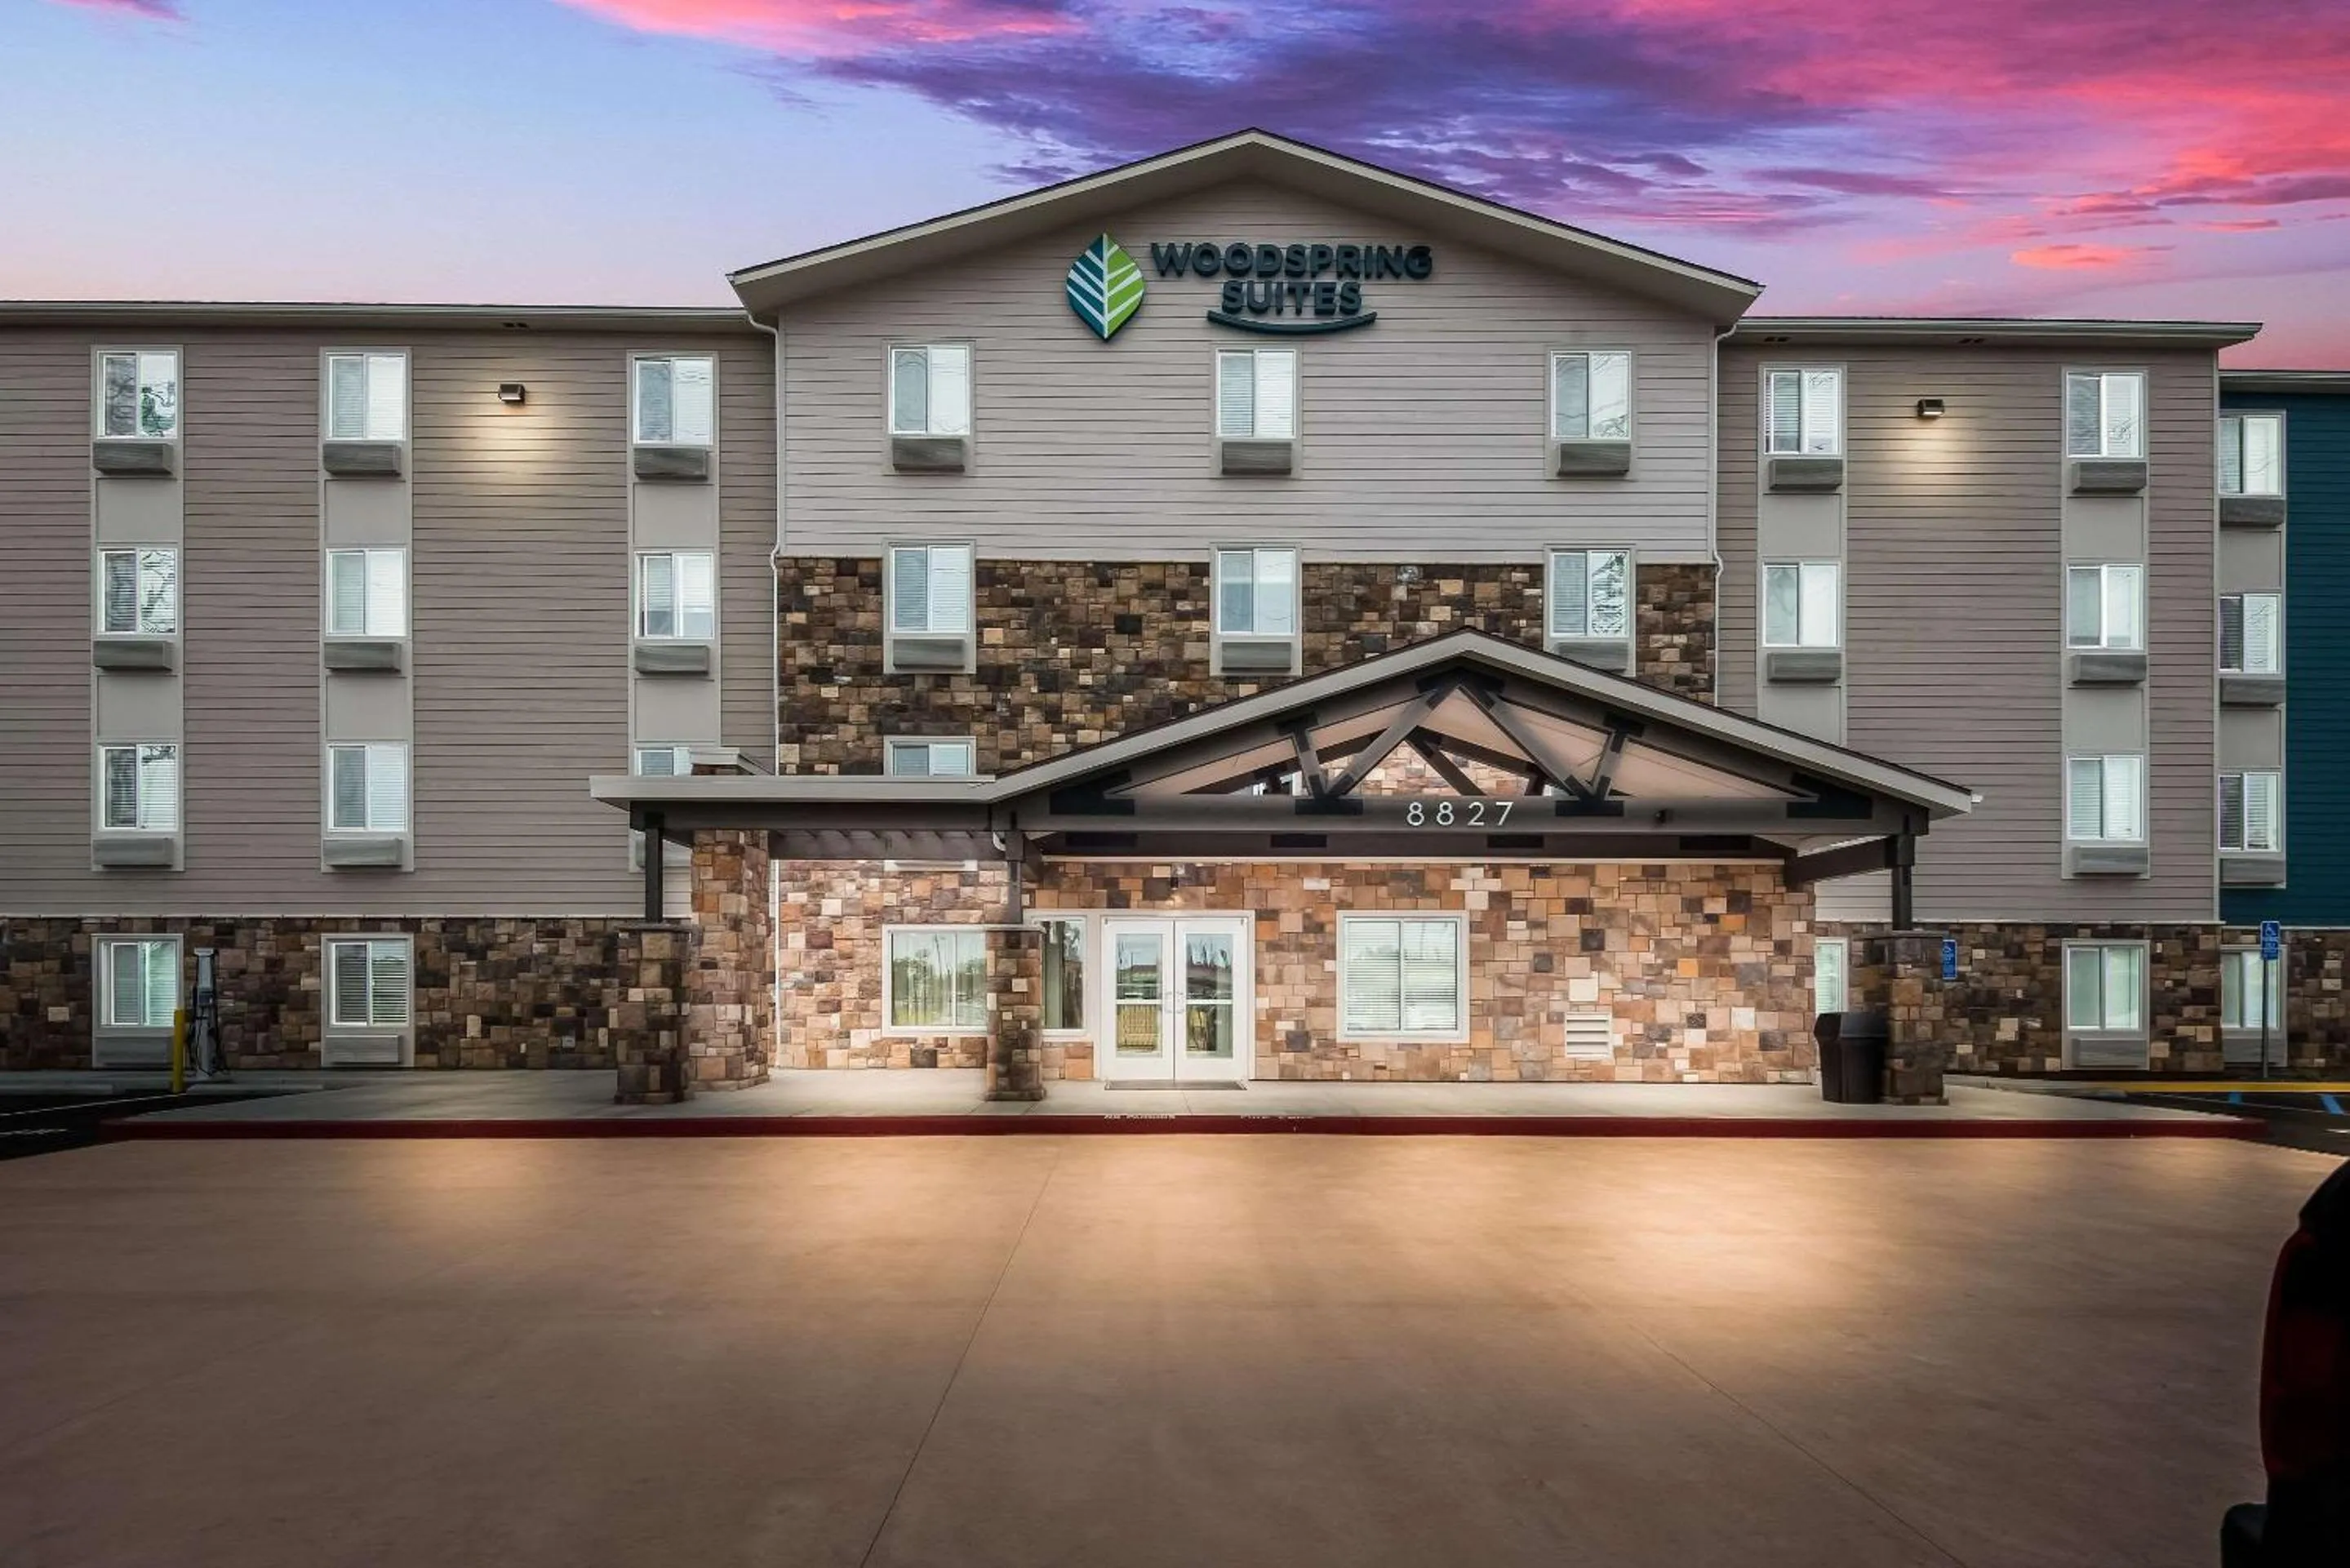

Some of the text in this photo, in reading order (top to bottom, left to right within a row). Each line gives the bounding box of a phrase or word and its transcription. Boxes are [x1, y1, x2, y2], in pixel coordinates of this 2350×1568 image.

[1152, 242, 1433, 279] WOODSPRING
[1221, 280, 1362, 315] SUITES
[1406, 802, 1513, 826] 8827
